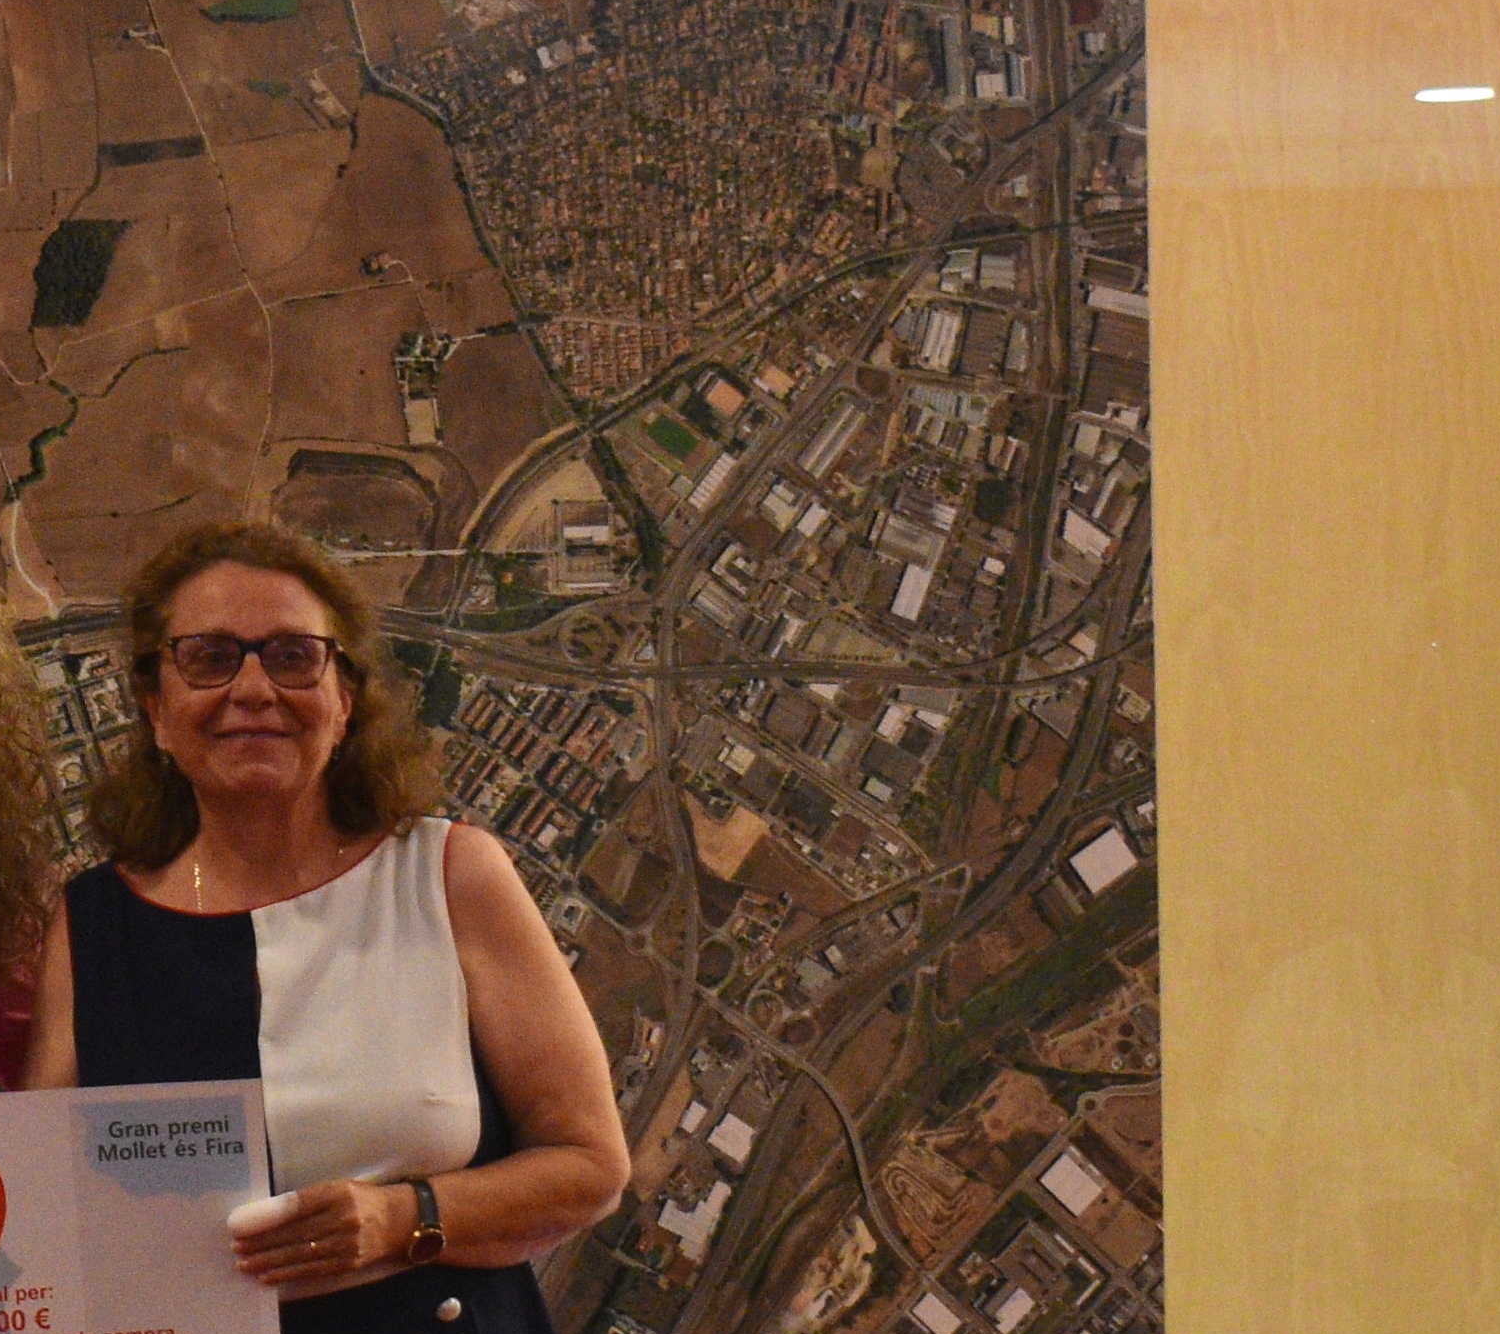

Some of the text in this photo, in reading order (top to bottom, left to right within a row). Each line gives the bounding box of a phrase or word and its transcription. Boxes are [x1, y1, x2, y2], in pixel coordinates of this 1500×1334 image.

[108, 1115, 229, 1140] Gran premi
[97, 1137, 245, 1162] Mollet és Fira
[15, 1286, 54, 1305] per:
[35, 1307, 51, 1330] €
